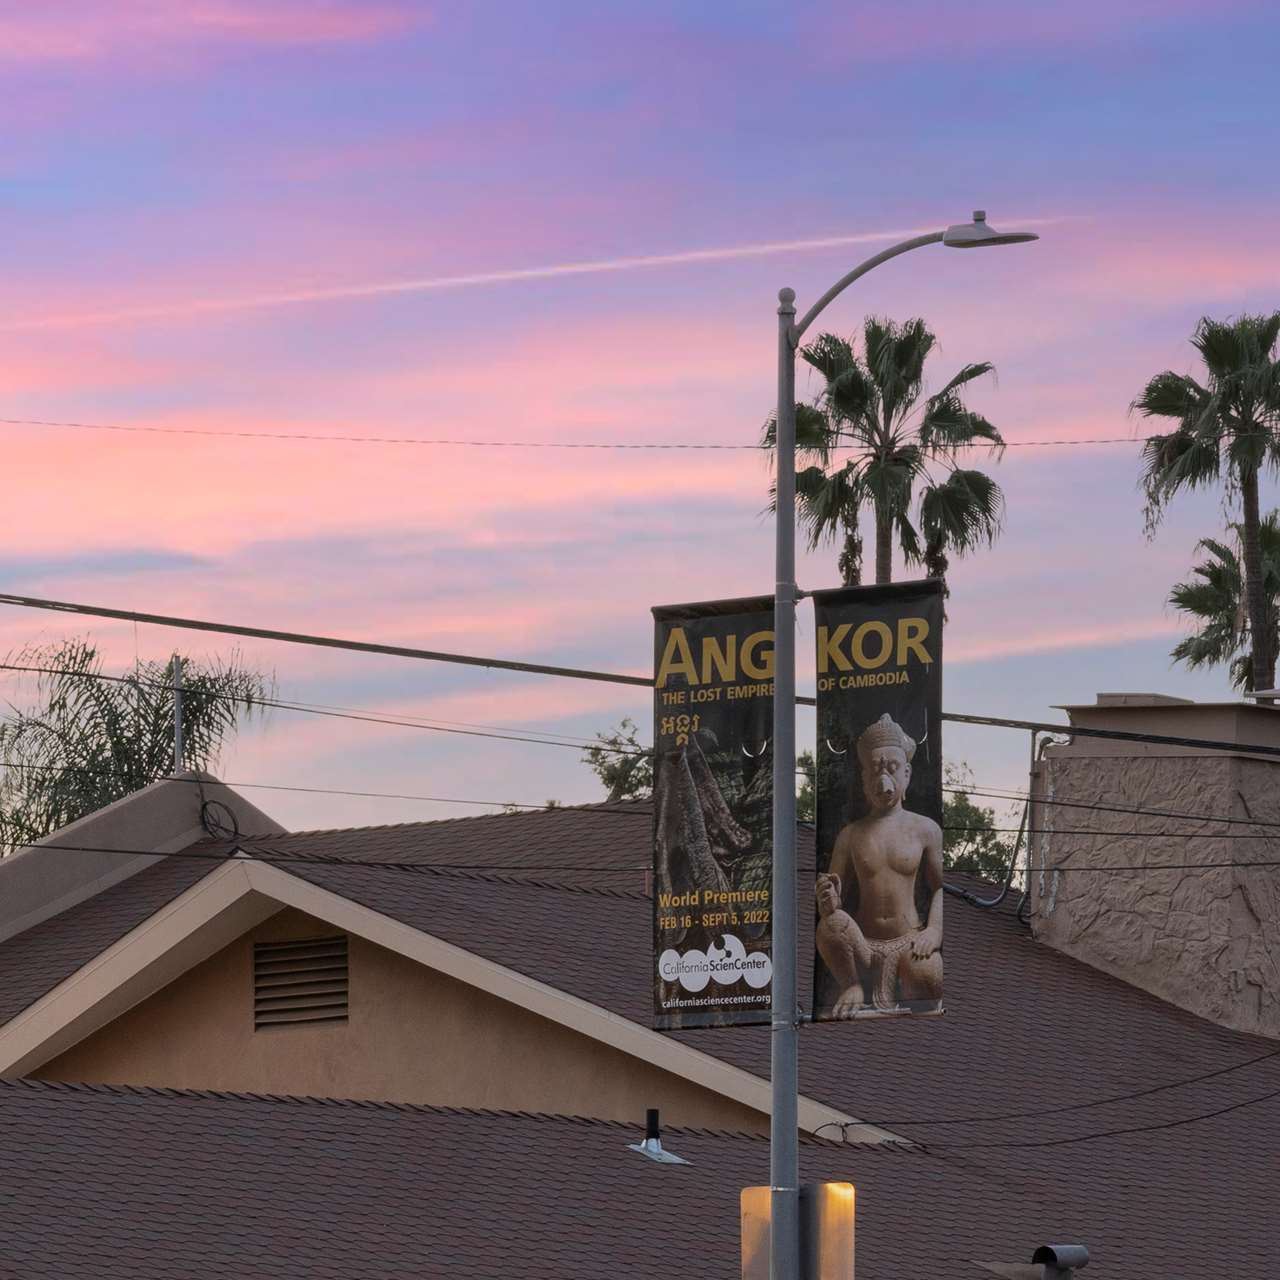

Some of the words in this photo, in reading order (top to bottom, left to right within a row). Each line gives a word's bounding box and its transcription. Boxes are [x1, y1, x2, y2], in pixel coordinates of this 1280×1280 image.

[818, 618, 934, 673] KOR
[818, 678, 835, 691] OF
[839, 671, 910, 689] CAMBODIA
[662, 691, 685, 705] THE
[690, 687, 721, 702] LOST
[727, 683, 775, 699] EMPIRE
[660, 890, 699, 908] World
[704, 889, 769, 905] Premiere
[660, 916, 677, 929] FEB
[681, 915, 691, 928] 16
[702, 912, 728, 927] SEPT
[731, 911, 740, 925] 5,
[744, 910, 769, 924] 2022
[662, 994, 771, 1009] californiasciencecenter.org
